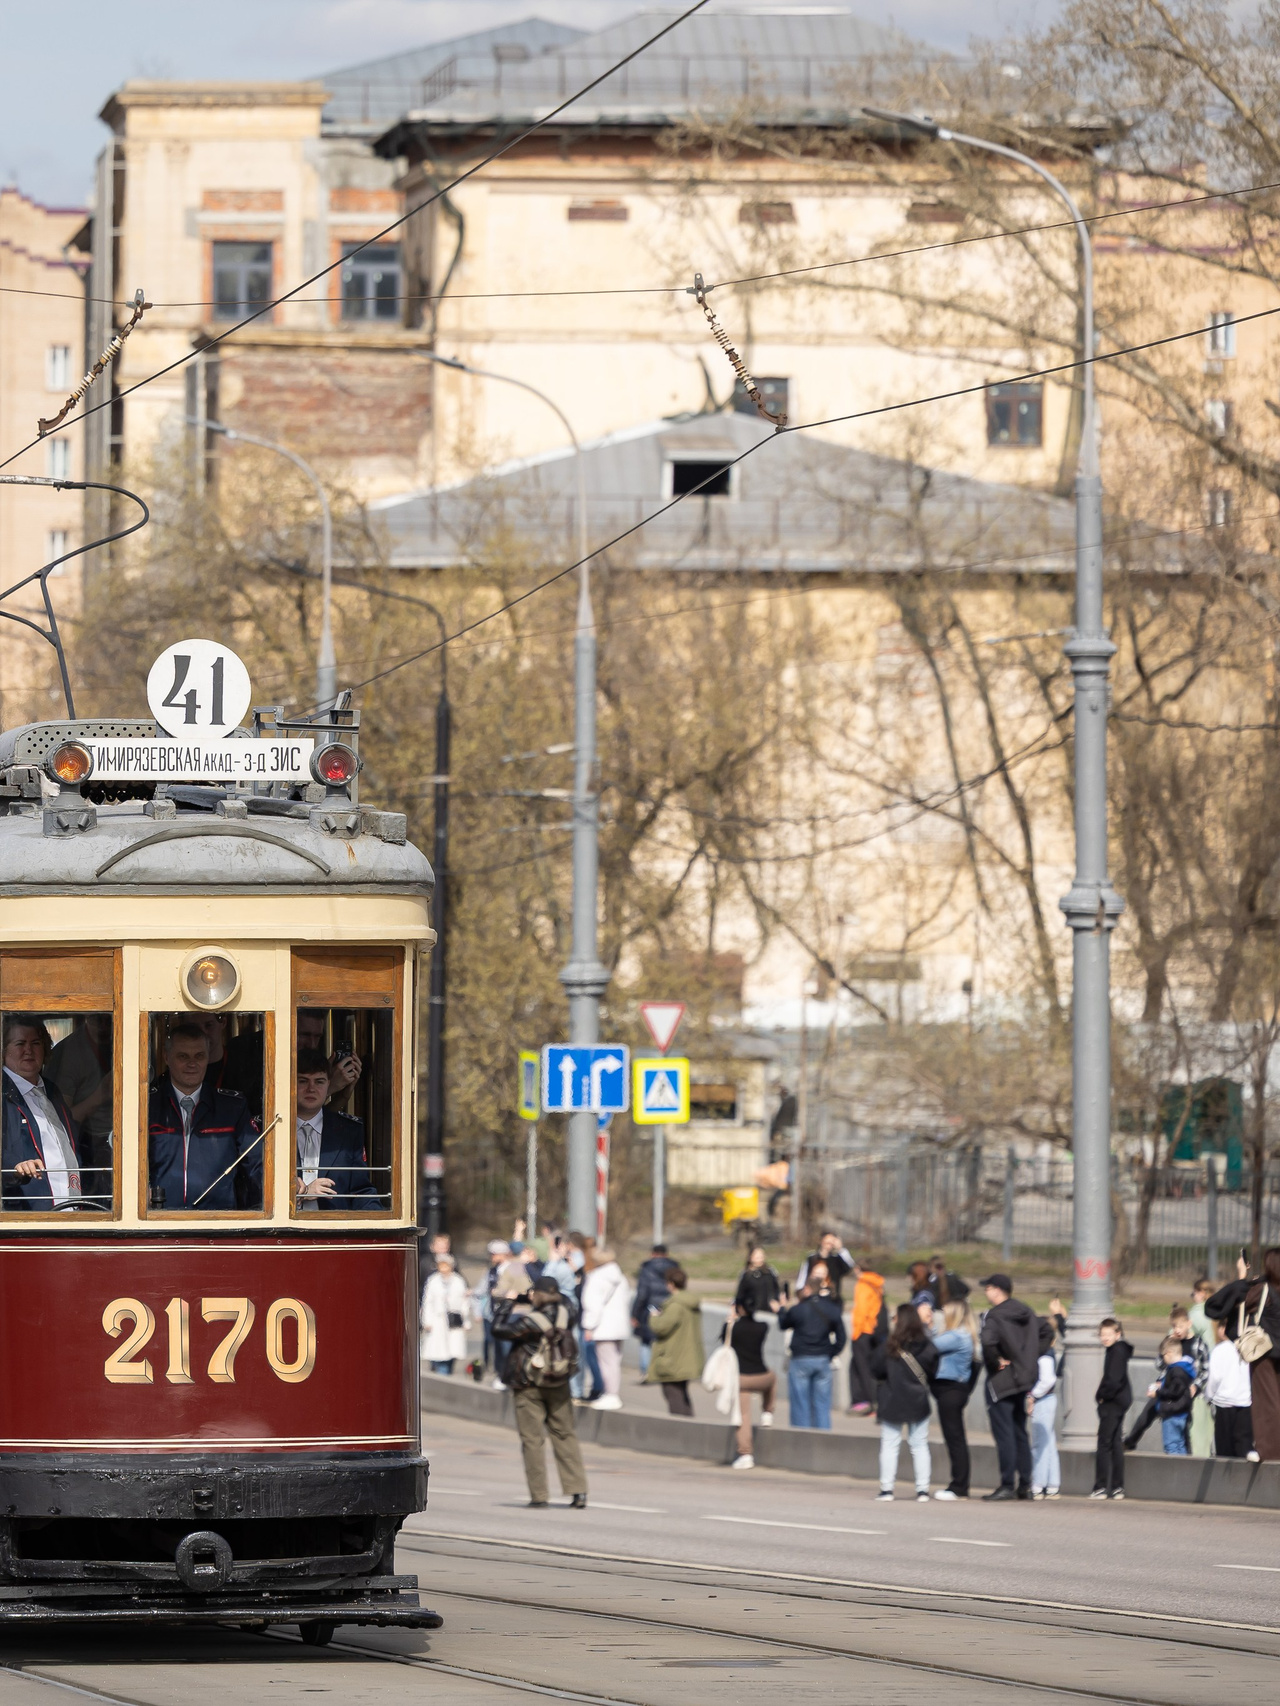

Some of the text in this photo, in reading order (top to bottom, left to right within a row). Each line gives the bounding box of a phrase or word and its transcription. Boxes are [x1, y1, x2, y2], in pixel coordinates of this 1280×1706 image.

[162, 654, 226, 726] 41
[270, 746, 301, 772] ЗИС
[102, 1297, 317, 1384] 2170
